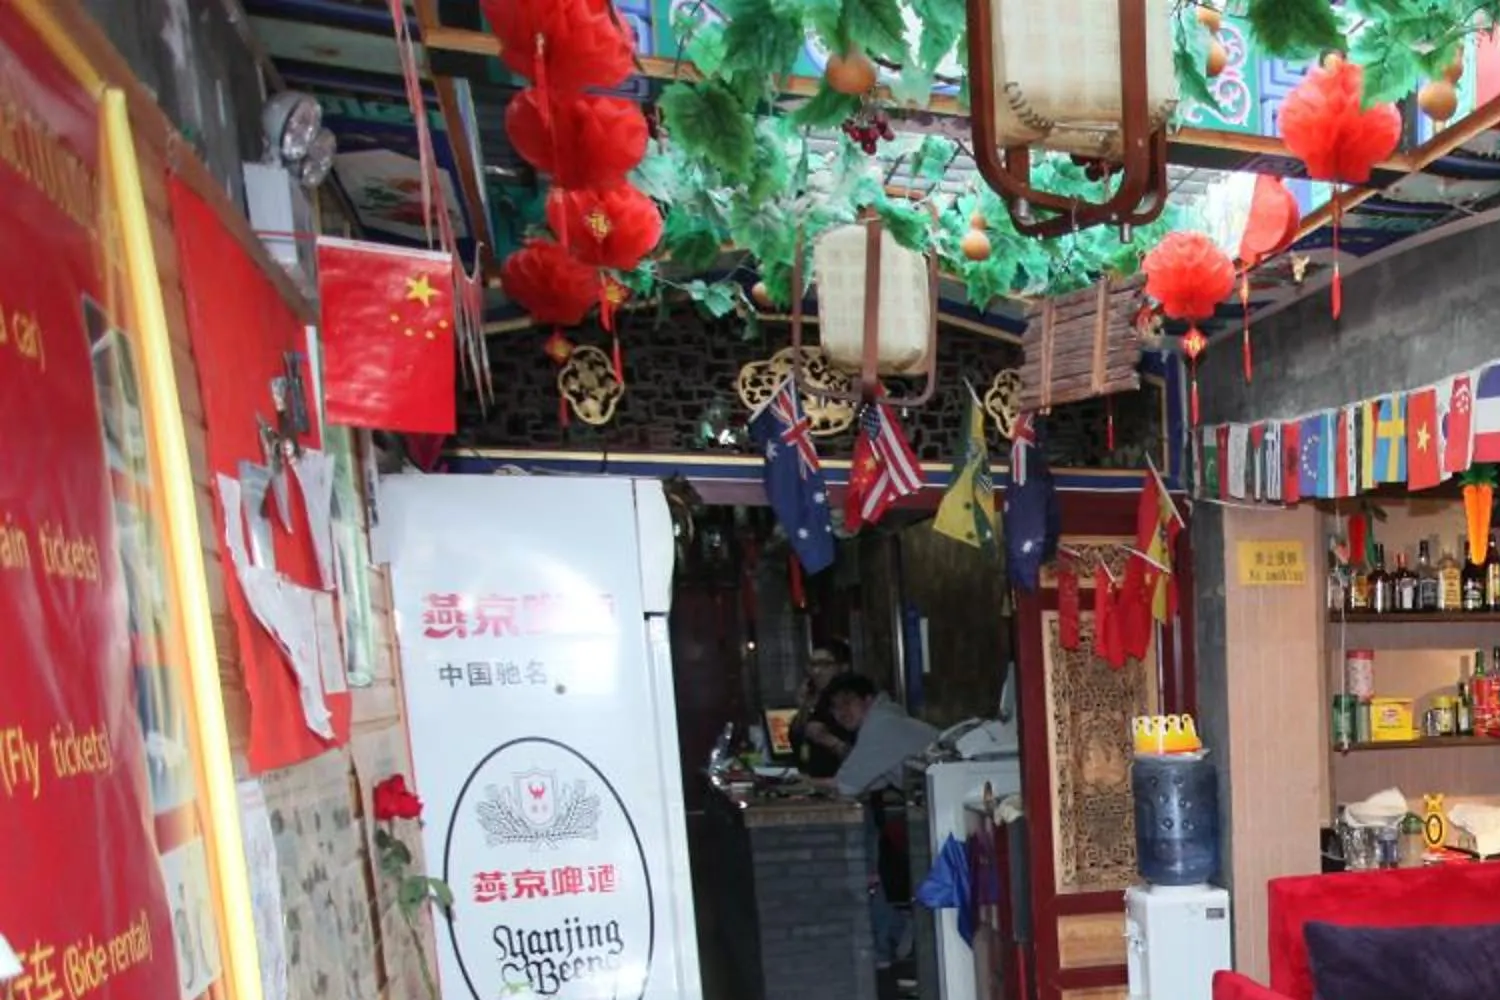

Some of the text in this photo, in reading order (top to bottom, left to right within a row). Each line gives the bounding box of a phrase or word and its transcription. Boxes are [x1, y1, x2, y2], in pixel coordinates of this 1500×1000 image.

[40, 516, 99, 583] tickets)
[49, 719, 113, 779] tickets)
[473, 863, 617, 905] 燕京啤酒
[492, 916, 625, 968] Yanjing
